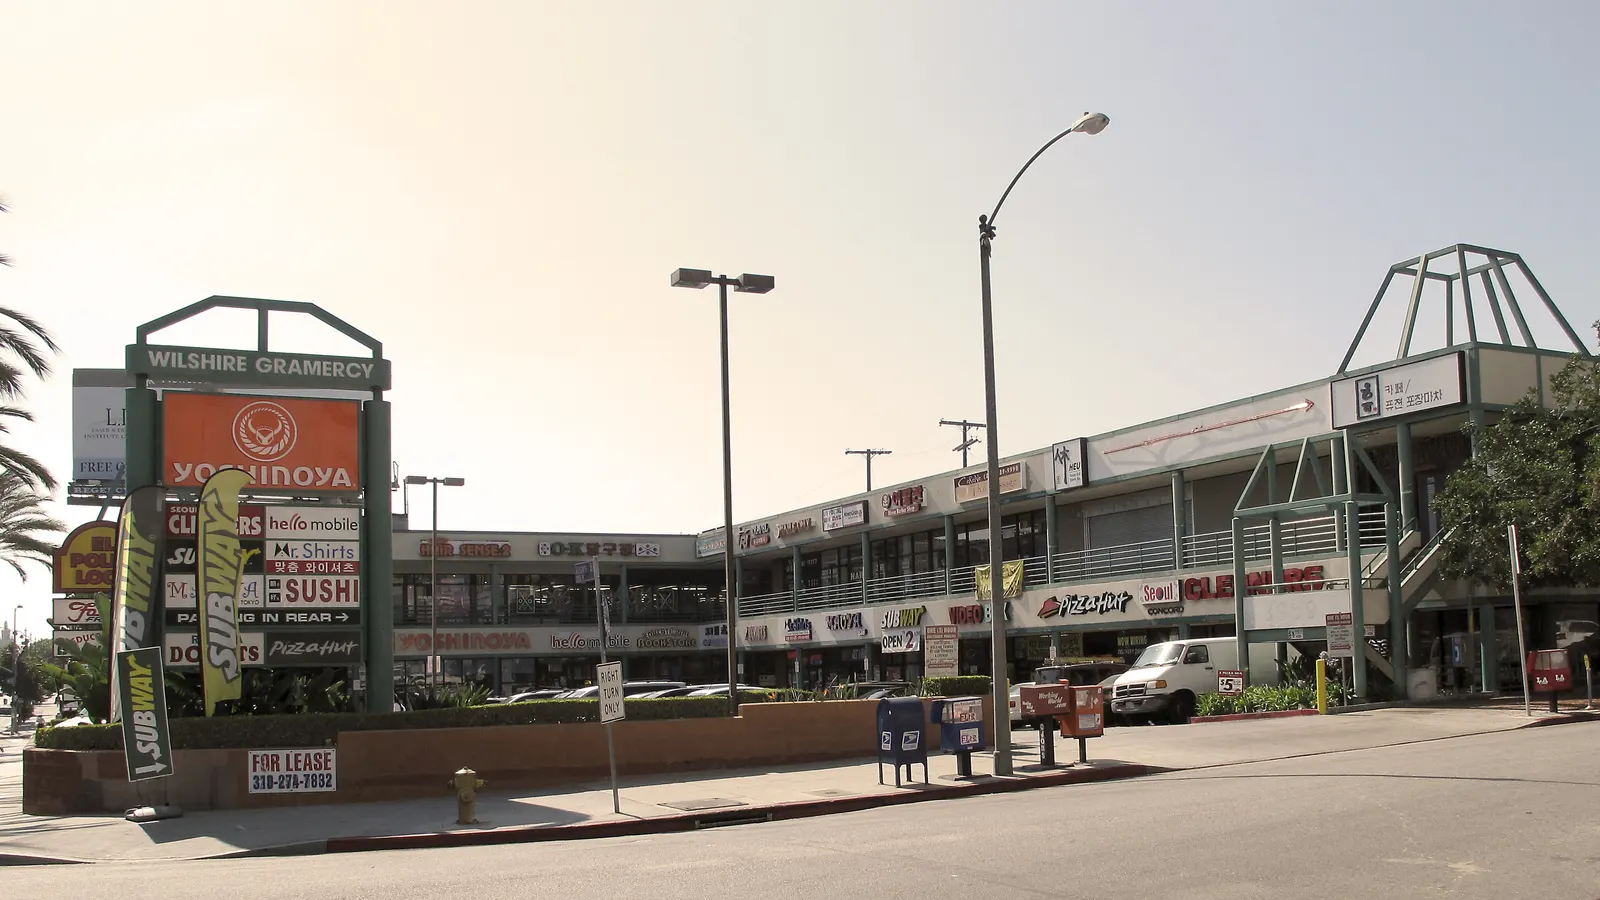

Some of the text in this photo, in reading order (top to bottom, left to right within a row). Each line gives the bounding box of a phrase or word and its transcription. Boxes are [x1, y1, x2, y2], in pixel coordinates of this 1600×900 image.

[148, 350, 374, 379] WILSHIRE GRAMERCY
[80, 462, 113, 472] FREE
[173, 462, 354, 487] YOHINOYA
[270, 513, 358, 530] hello mobile
[303, 543, 354, 559] Shirts
[460, 543, 500, 556] SENSE
[275, 562, 354, 573] 맞춤 와이셔츠
[201, 488, 241, 684] SUBWAY
[286, 578, 359, 602] SUSHI
[1143, 583, 1174, 602] Seoul
[262, 614, 279, 622] IN
[286, 613, 332, 622] REAR
[881, 605, 927, 629] SUBWAY
[948, 604, 983, 625] VIDEO
[1147, 606, 1184, 616] CONCORD
[552, 631, 631, 648] hello mbile
[636, 638, 697, 648] BOOKSTORE
[882, 635, 903, 649] OPEN
[601, 670, 619, 683] RIGHT
[603, 687, 620, 700] TURN
[126, 653, 162, 760] SUBWAY
[604, 702, 620, 715] ONLY
[252, 753, 332, 773] FOR LEASE
